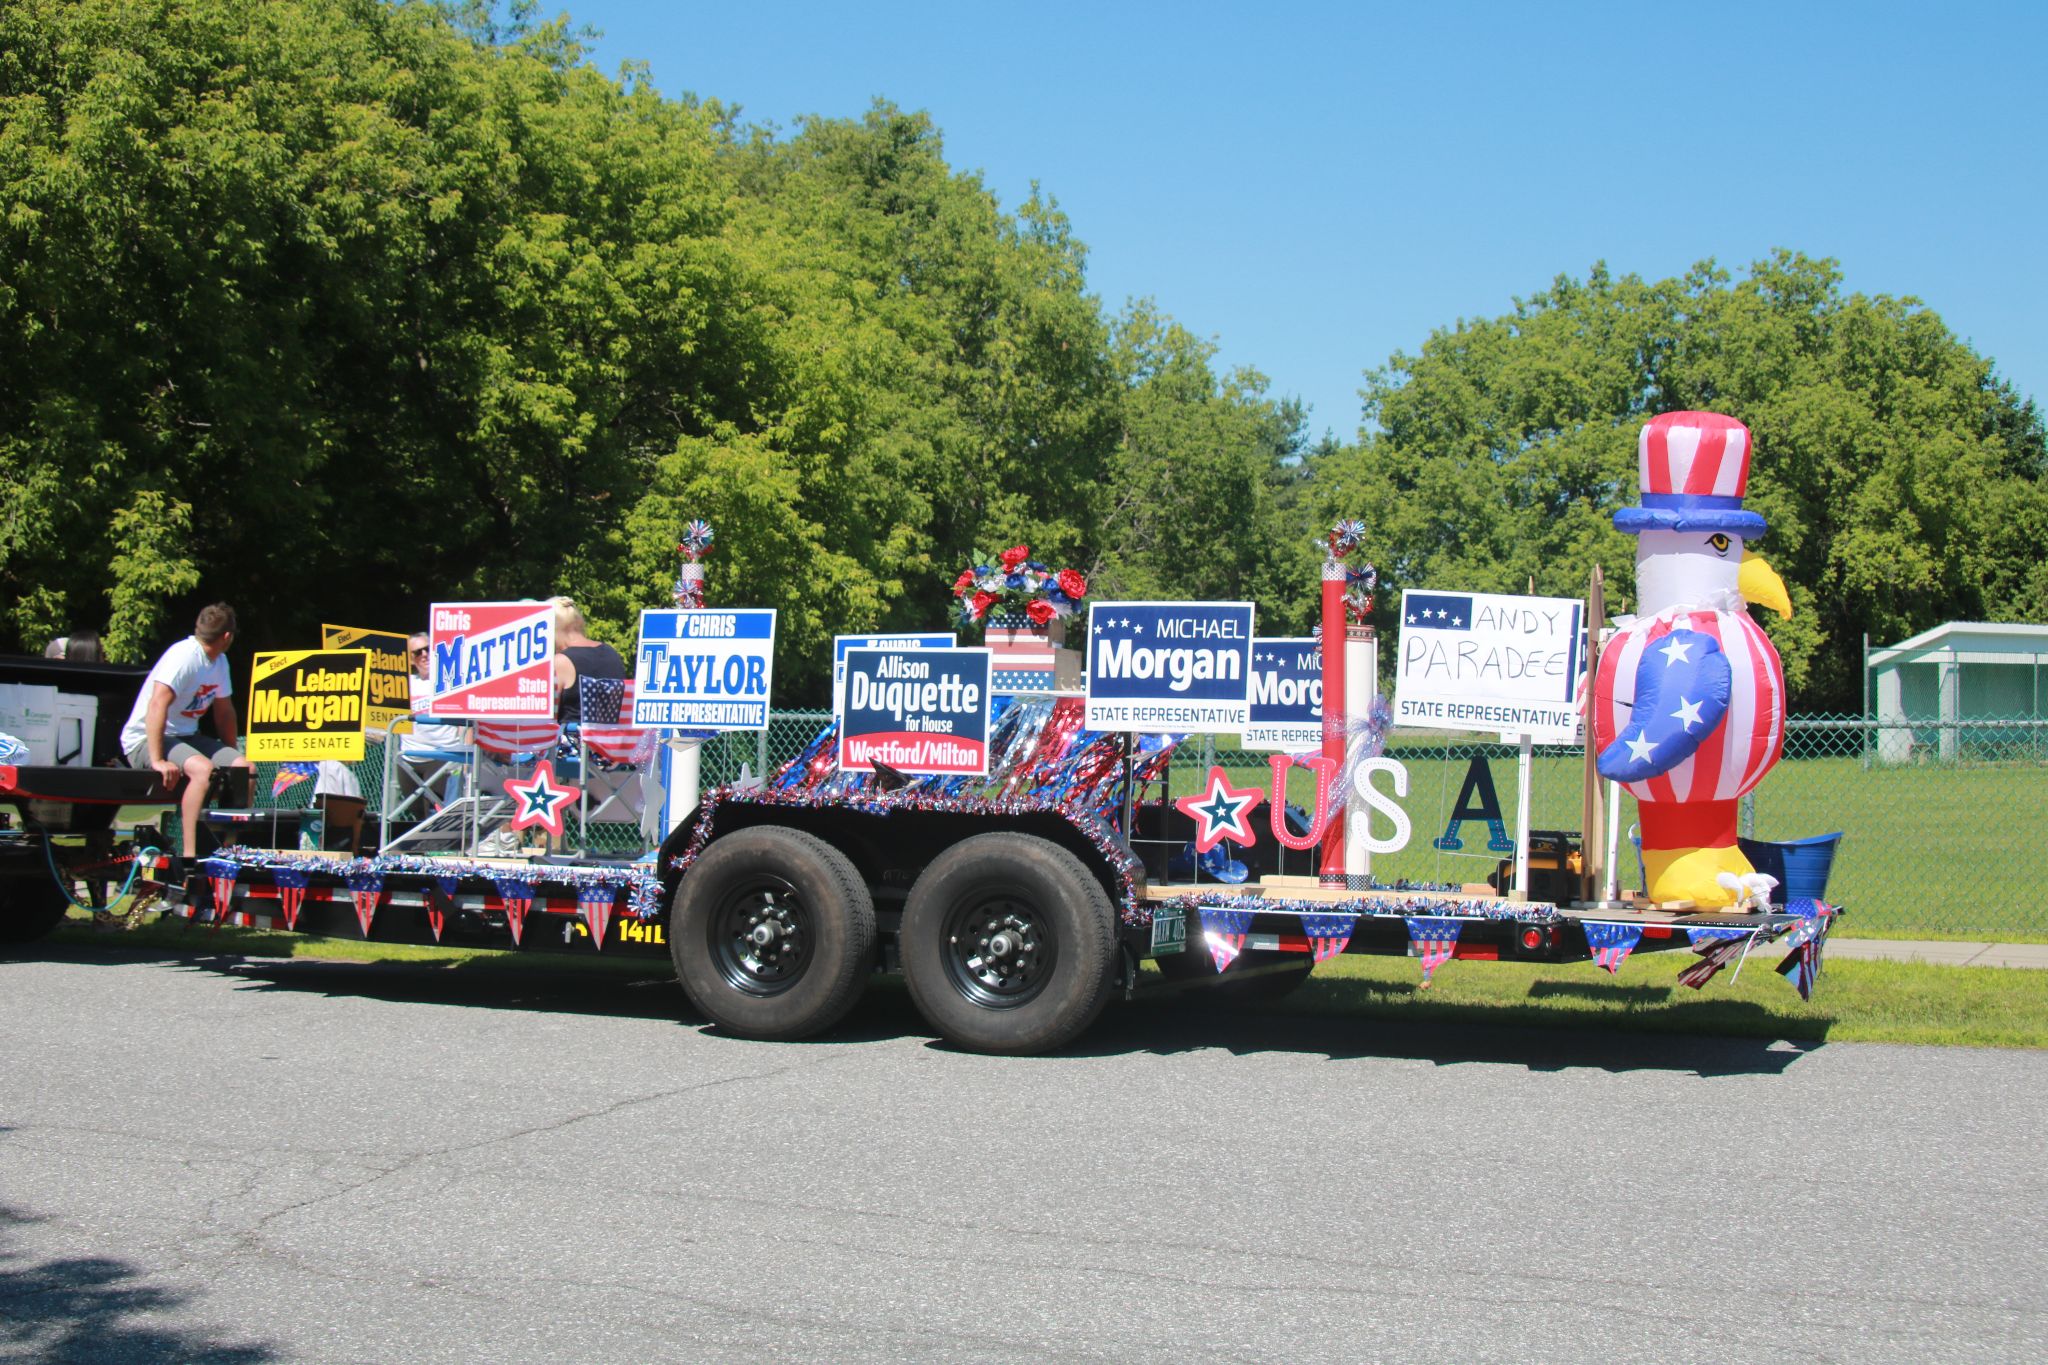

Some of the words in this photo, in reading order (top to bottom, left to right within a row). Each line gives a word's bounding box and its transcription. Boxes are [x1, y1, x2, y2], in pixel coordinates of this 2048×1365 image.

[436, 610, 471, 631] Chris
[688, 614, 737, 637] CHRIS
[1156, 618, 1245, 639] MICHAEL
[1475, 605, 1560, 636] ANDY
[269, 656, 288, 671] Elect
[370, 647, 407, 673] eland
[434, 620, 548, 696] MATTOS
[640, 641, 768, 696] TAYLOR
[876, 655, 930, 679] Allison
[1097, 638, 1241, 691] Morgan
[1405, 635, 1567, 680] PARADEE
[295, 667, 363, 692] Leland
[369, 673, 409, 704] gan
[518, 677, 548, 693] State
[468, 694, 548, 712] Representative
[851, 671, 979, 722] Duquette
[253, 689, 360, 730] Morgan
[637, 702, 670, 723] STATE
[671, 703, 763, 724] REPRESENTATIVE
[1091, 707, 1129, 721] STATE
[1132, 707, 1246, 723] REPRESENTATIVE
[1401, 700, 1443, 718] STATE
[1447, 703, 1570, 727] REPRESENTATIVE
[905, 714, 920, 732] for
[921, 715, 953, 733] House
[1246, 729, 1279, 742] STATE
[259, 738, 294, 750] STATE
[303, 737, 351, 749] SENATE
[849, 740, 978, 767] Westford/Milton
